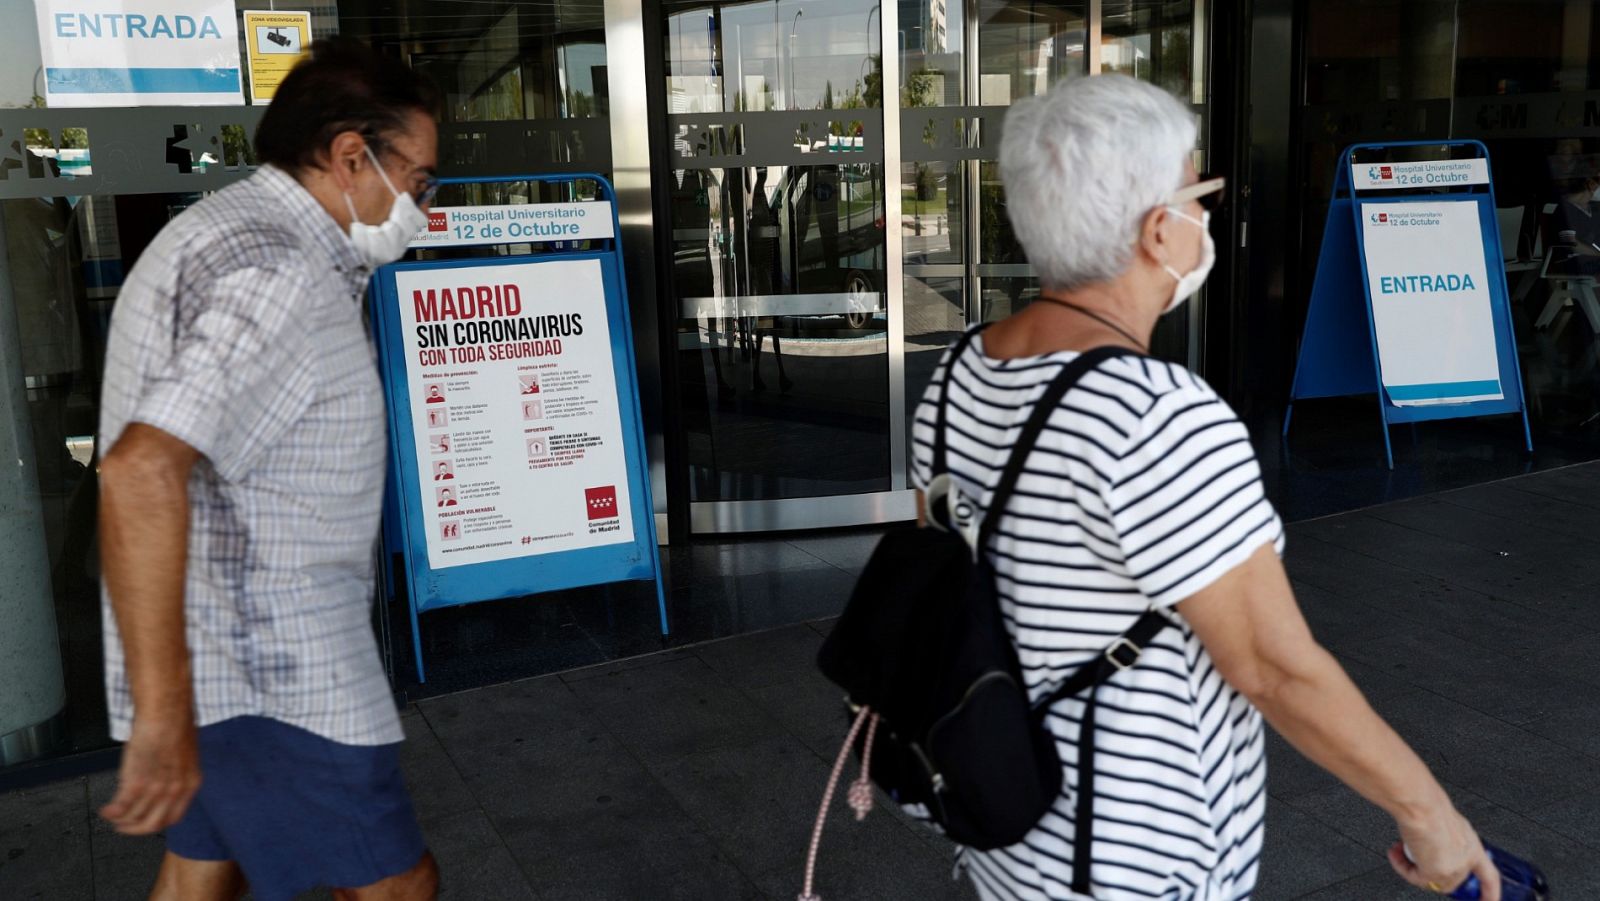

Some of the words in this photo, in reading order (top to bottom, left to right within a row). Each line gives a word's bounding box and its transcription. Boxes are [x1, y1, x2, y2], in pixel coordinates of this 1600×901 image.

[55, 12, 221, 39] ENTRADA
[1394, 165, 1424, 174] Hospital
[1425, 163, 1471, 171] Universitario
[1396, 176, 1408, 184] 12
[1411, 175, 1423, 183] de
[1426, 172, 1468, 182] Octubre
[452, 210, 504, 224] Hospital
[508, 207, 585, 220] Universitario
[453, 225, 475, 240] 12
[481, 222, 502, 238] de
[508, 220, 579, 237] Octubre
[1381, 274, 1475, 294] ENTRADA
[413, 284, 522, 322] MADRID
[416, 323, 449, 348] SIN
[454, 313, 583, 345] CORONAVIRUS
[419, 349, 447, 366] CON
[450, 345, 486, 364] TODA
[489, 339, 563, 360] SEGURIDAD
[439, 510, 465, 518] POBLACIÓN
[589, 520, 619, 528] Comunidad
[598, 525, 620, 533] Madrid
